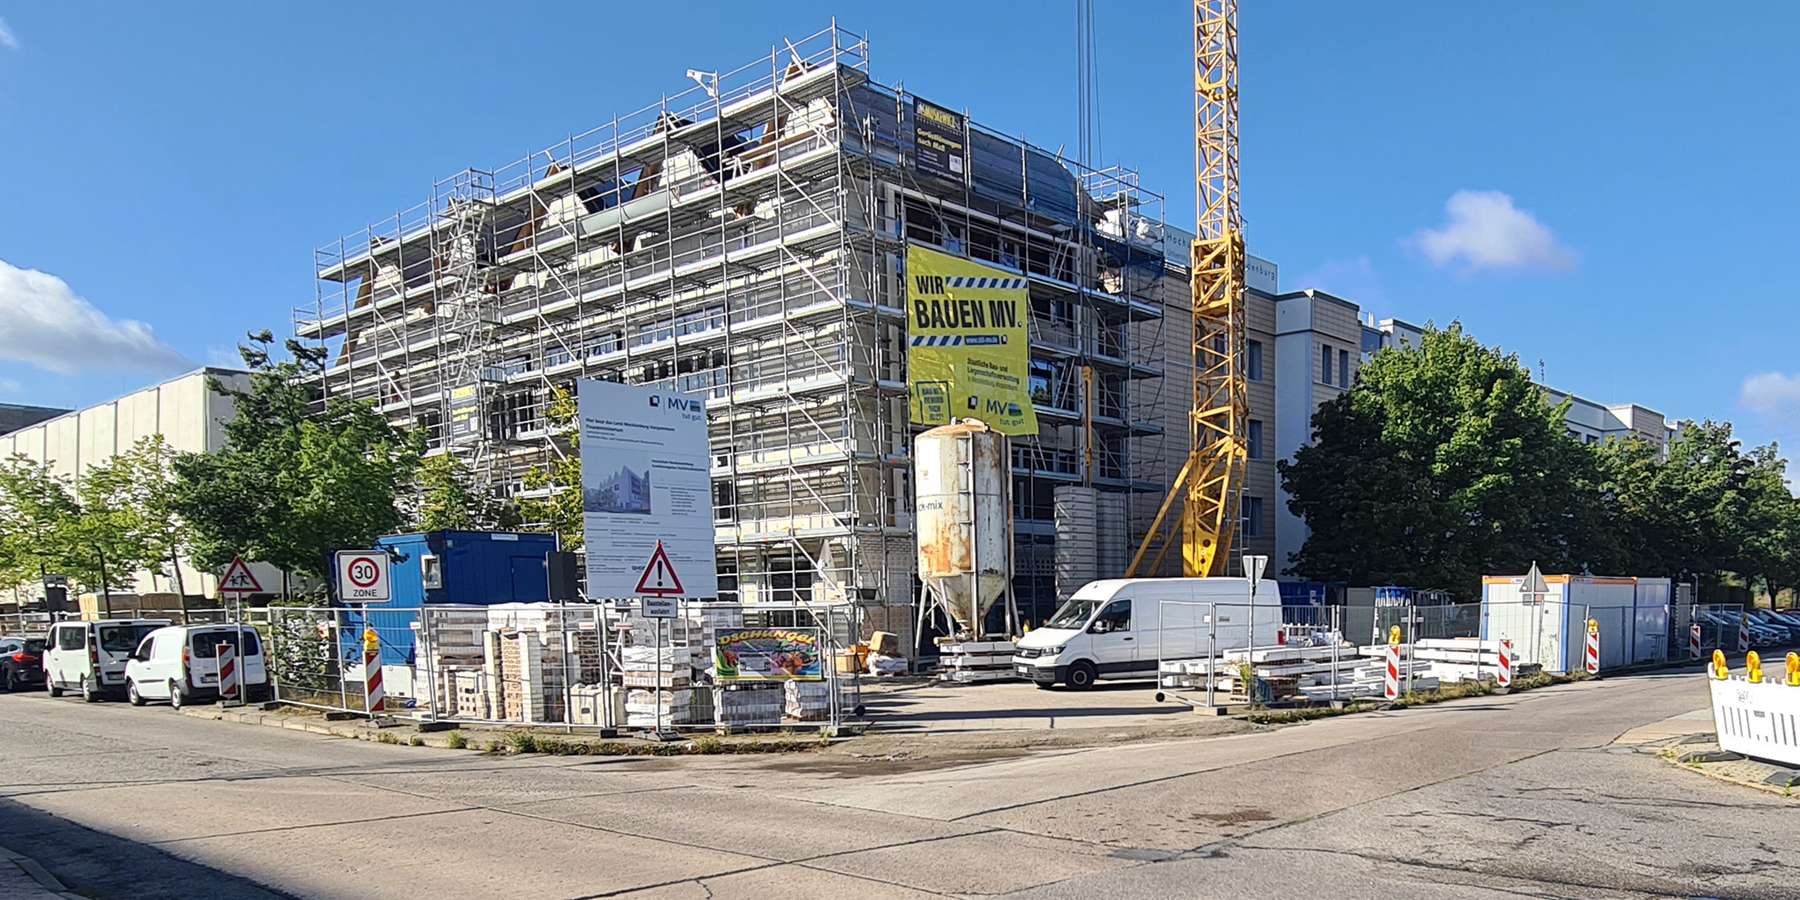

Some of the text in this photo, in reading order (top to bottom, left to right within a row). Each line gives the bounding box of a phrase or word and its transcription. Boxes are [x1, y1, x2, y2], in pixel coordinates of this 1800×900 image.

[915, 275, 945, 294] WIR
[914, 299, 1023, 329] BAUEN MV.
[668, 397, 689, 411] MV
[986, 399, 1008, 415] MV
[354, 565, 373, 580] 30
[353, 589, 378, 598] ZONE
